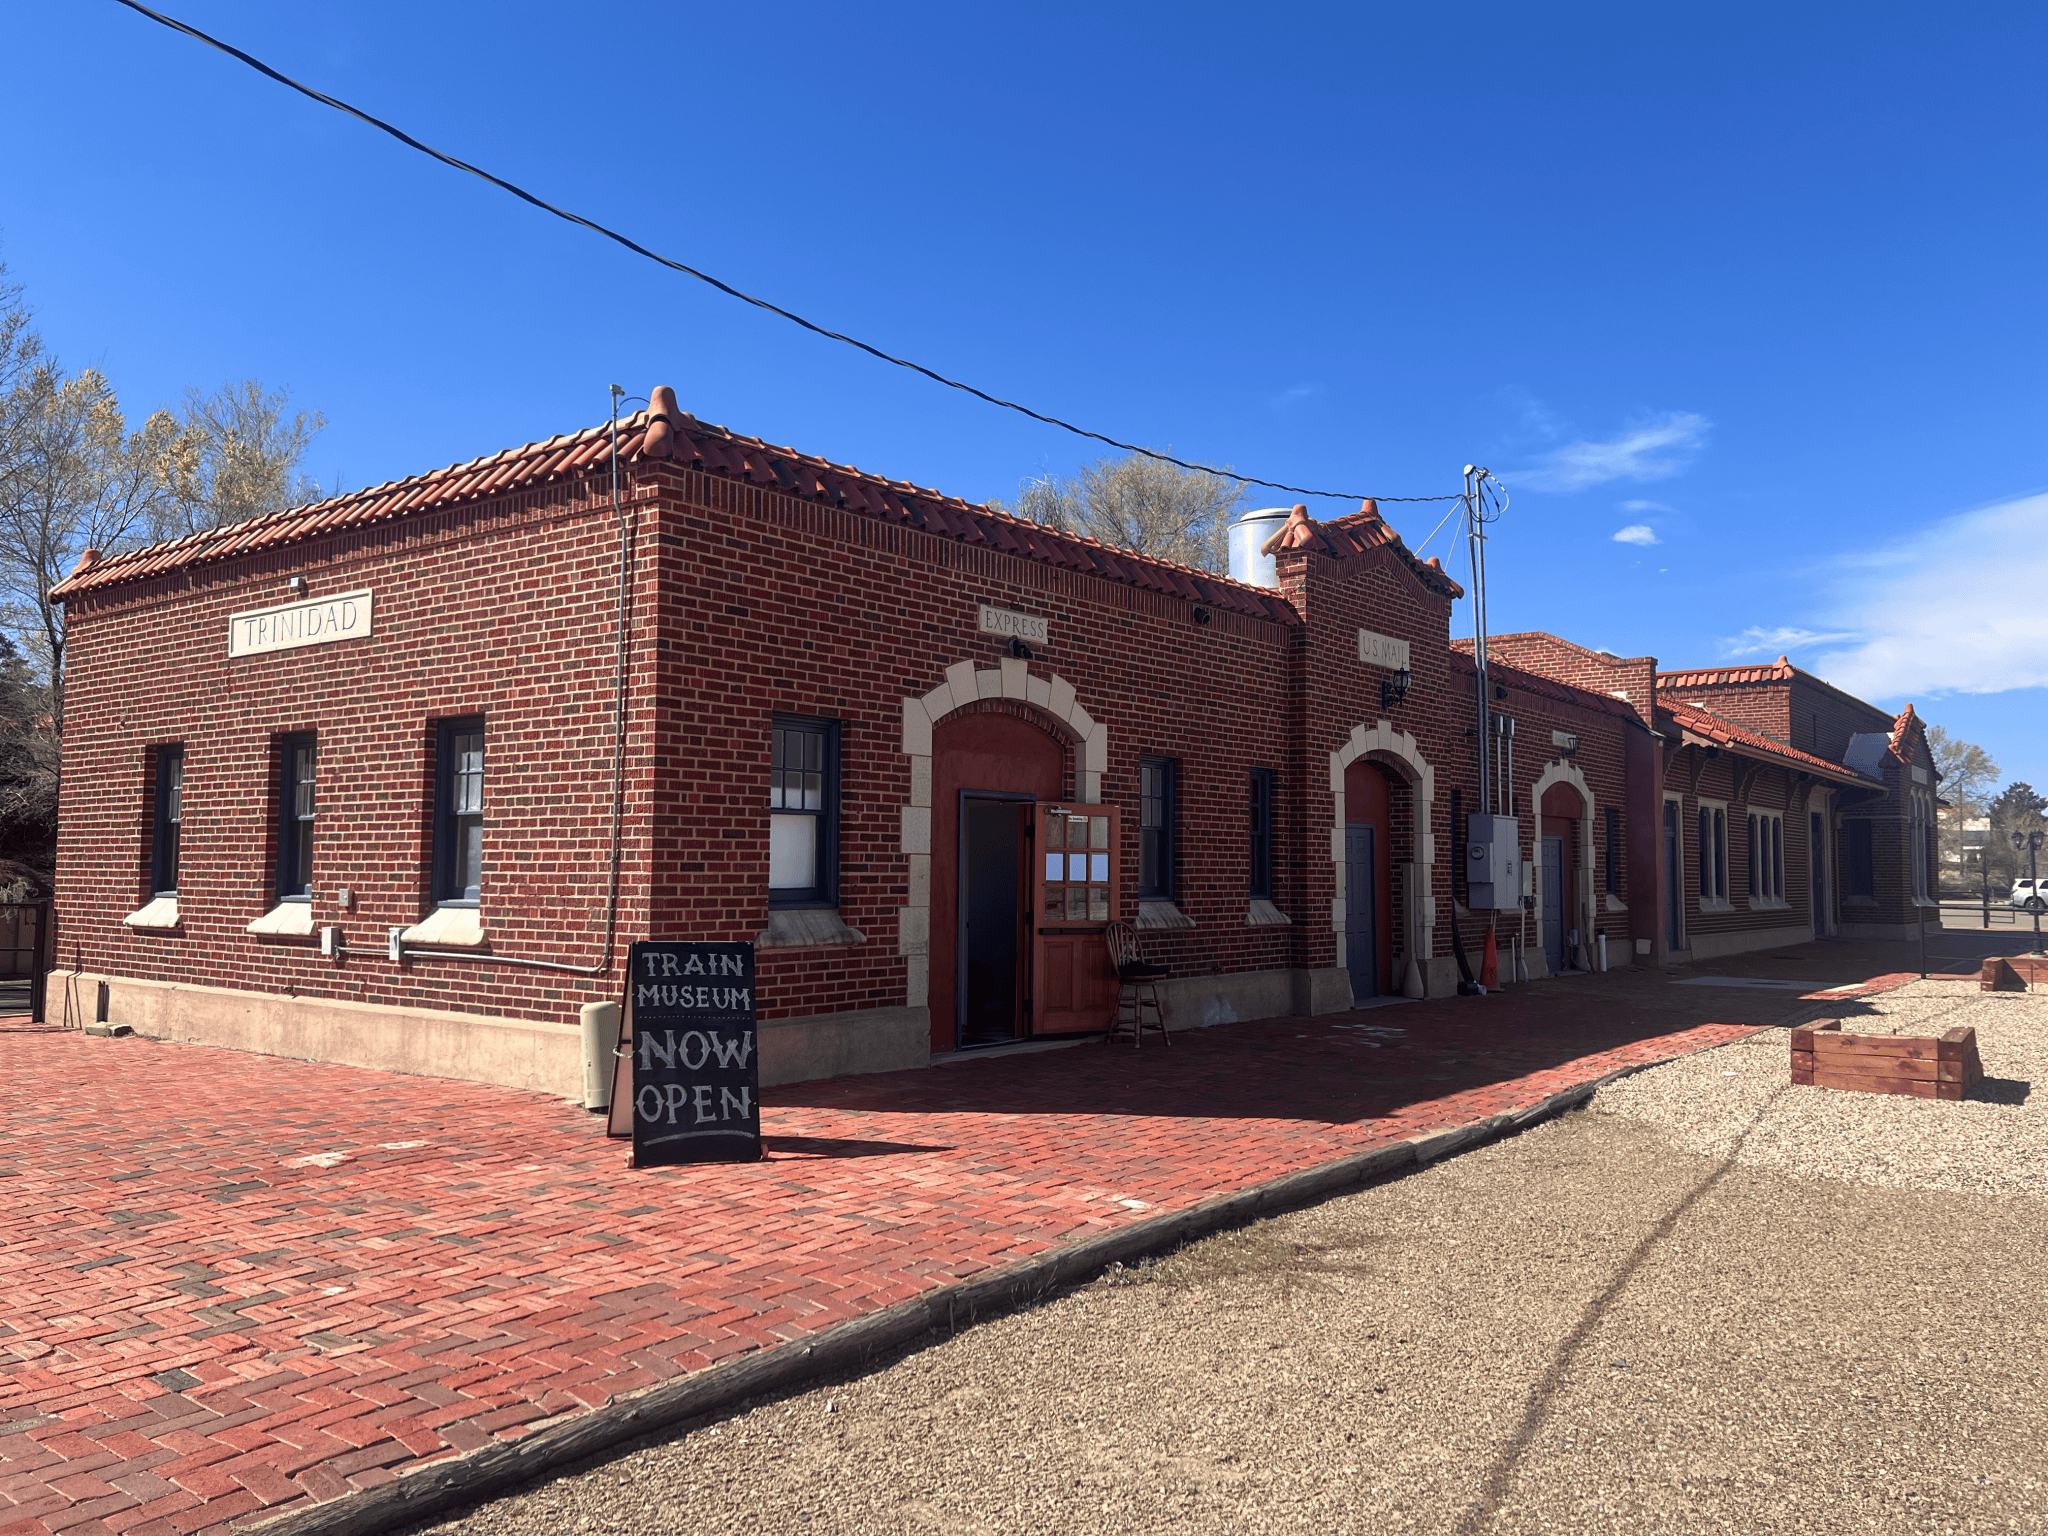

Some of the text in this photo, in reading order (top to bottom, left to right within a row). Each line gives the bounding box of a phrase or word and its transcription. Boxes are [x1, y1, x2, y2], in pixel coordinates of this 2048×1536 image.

[244, 601, 357, 646] TRINIDAD
[985, 610, 1044, 638] EXPRESS
[1381, 640, 1407, 665] MAIL
[641, 952, 744, 977] TRAIN
[637, 984, 752, 1011] MUSEUM
[638, 1029, 753, 1071] NOW
[635, 1083, 752, 1125] OPEN
